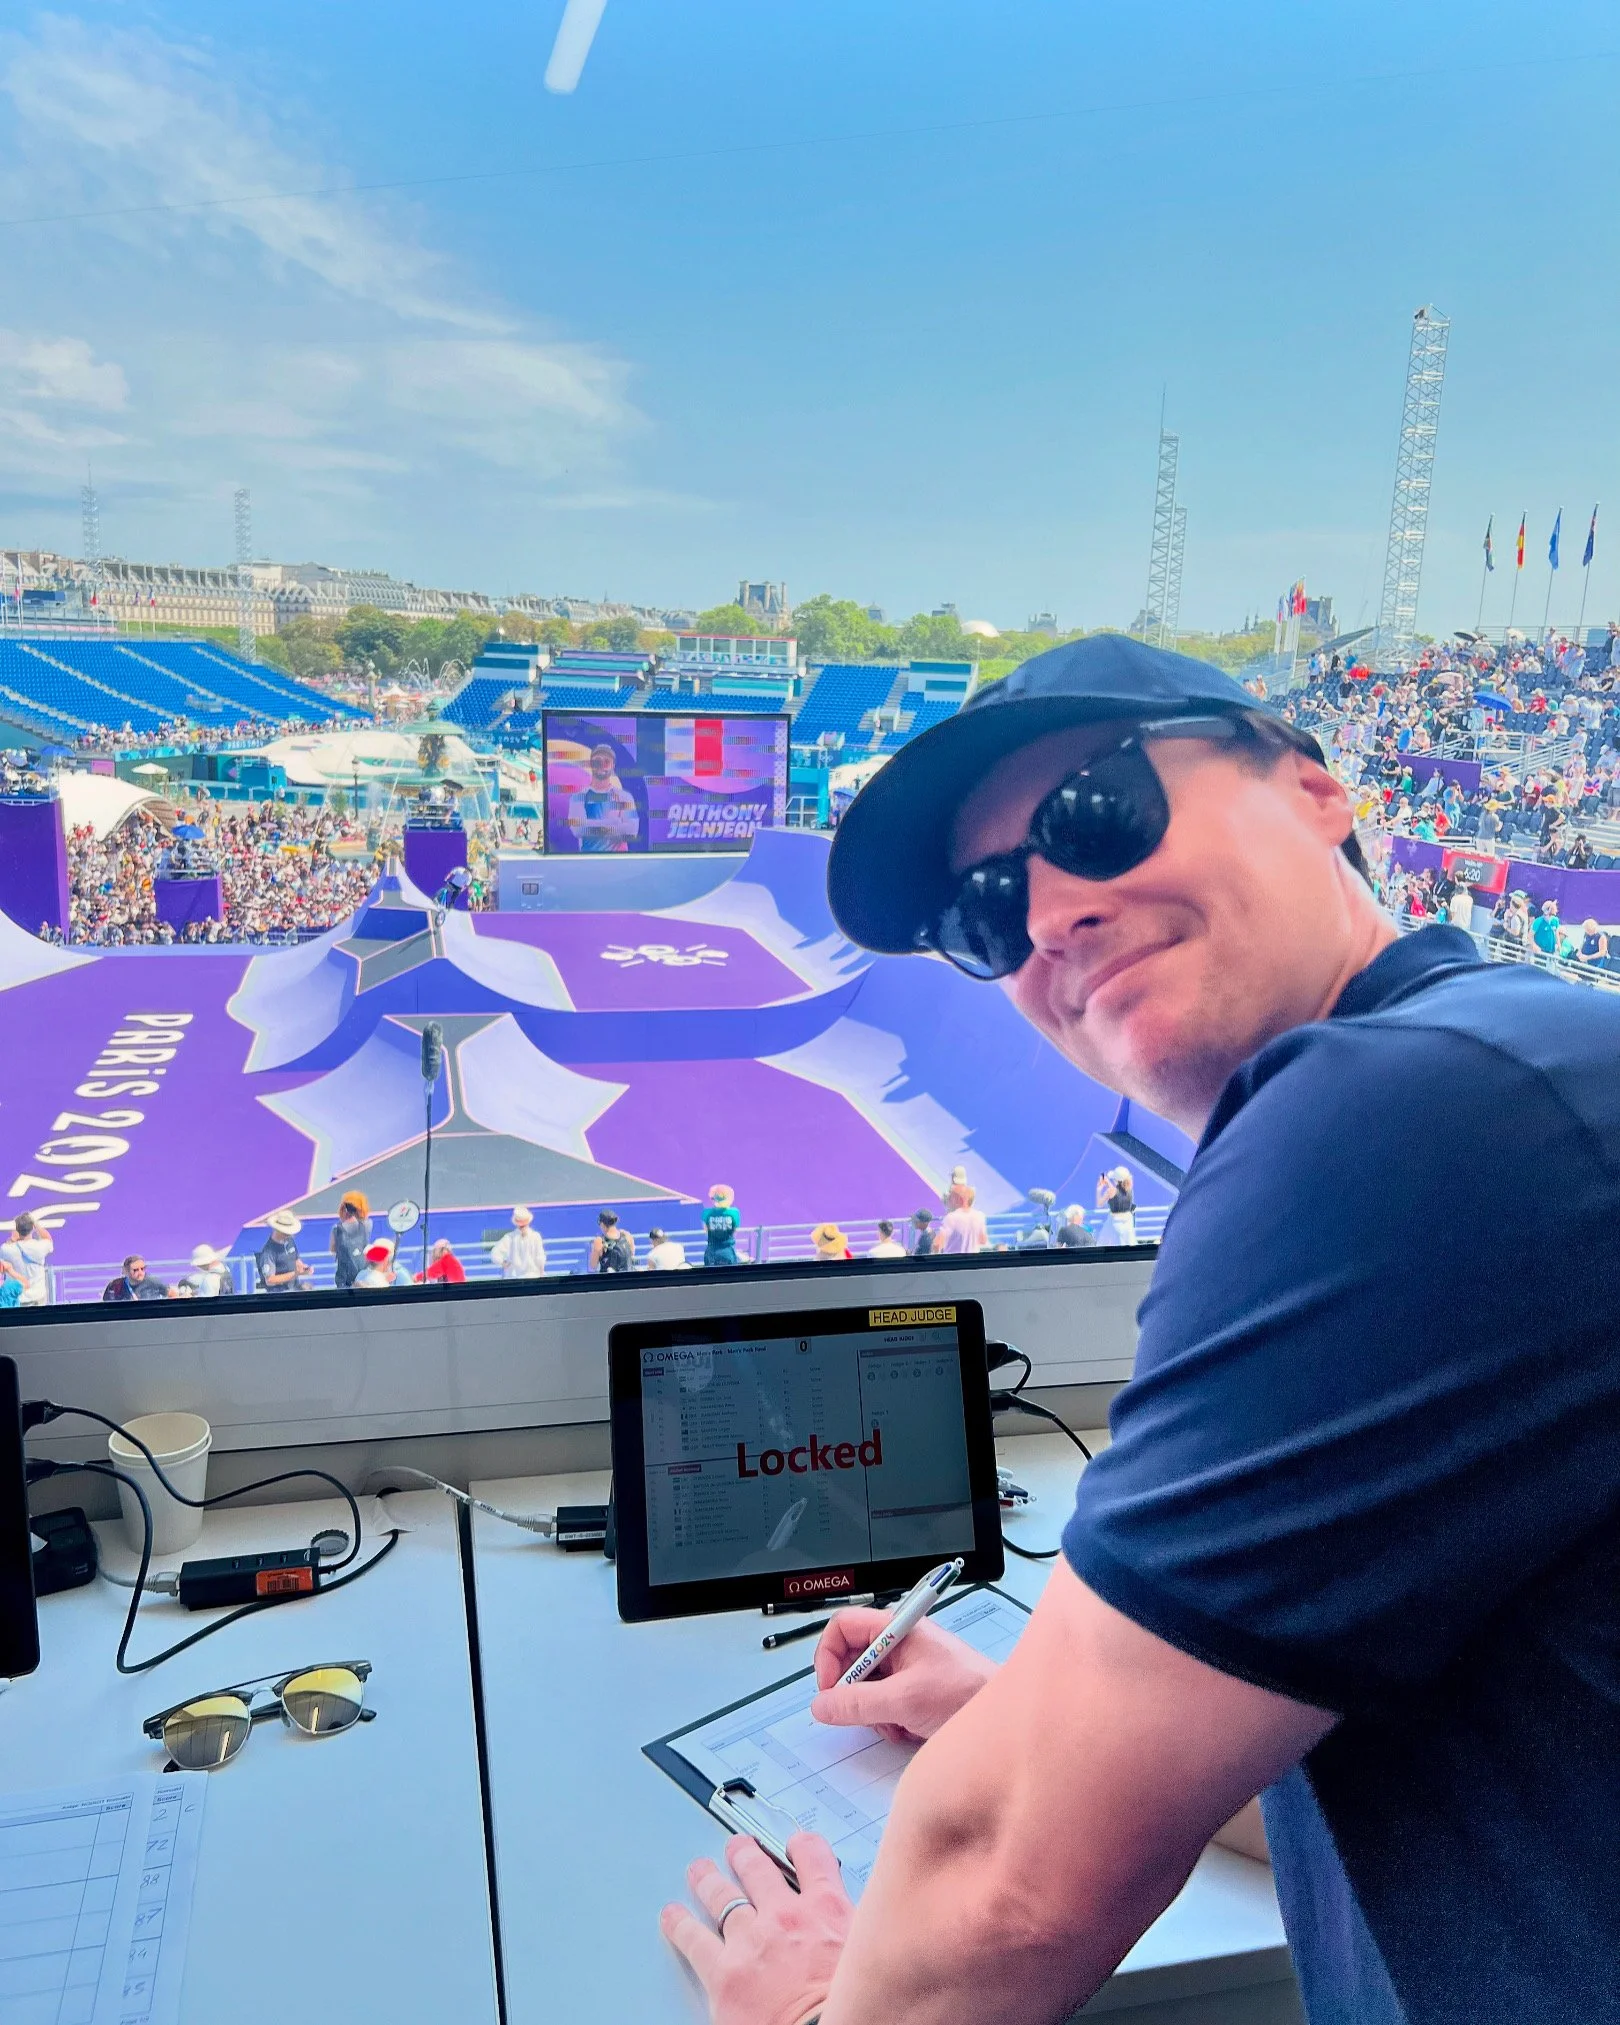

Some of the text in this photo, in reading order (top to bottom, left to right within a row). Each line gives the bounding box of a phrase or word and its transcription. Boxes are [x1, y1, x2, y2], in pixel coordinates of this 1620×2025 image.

[667, 804, 767, 821] ANTHONY
[873, 1309, 953, 1323] HEAD JUDGE
[799, 1341, 808, 1352] 0
[657, 1351, 695, 1362] OMEGA
[736, 1428, 883, 1479] Locked
[803, 1575, 850, 1591] OMEGA
[870, 1632, 896, 1659] 2024
